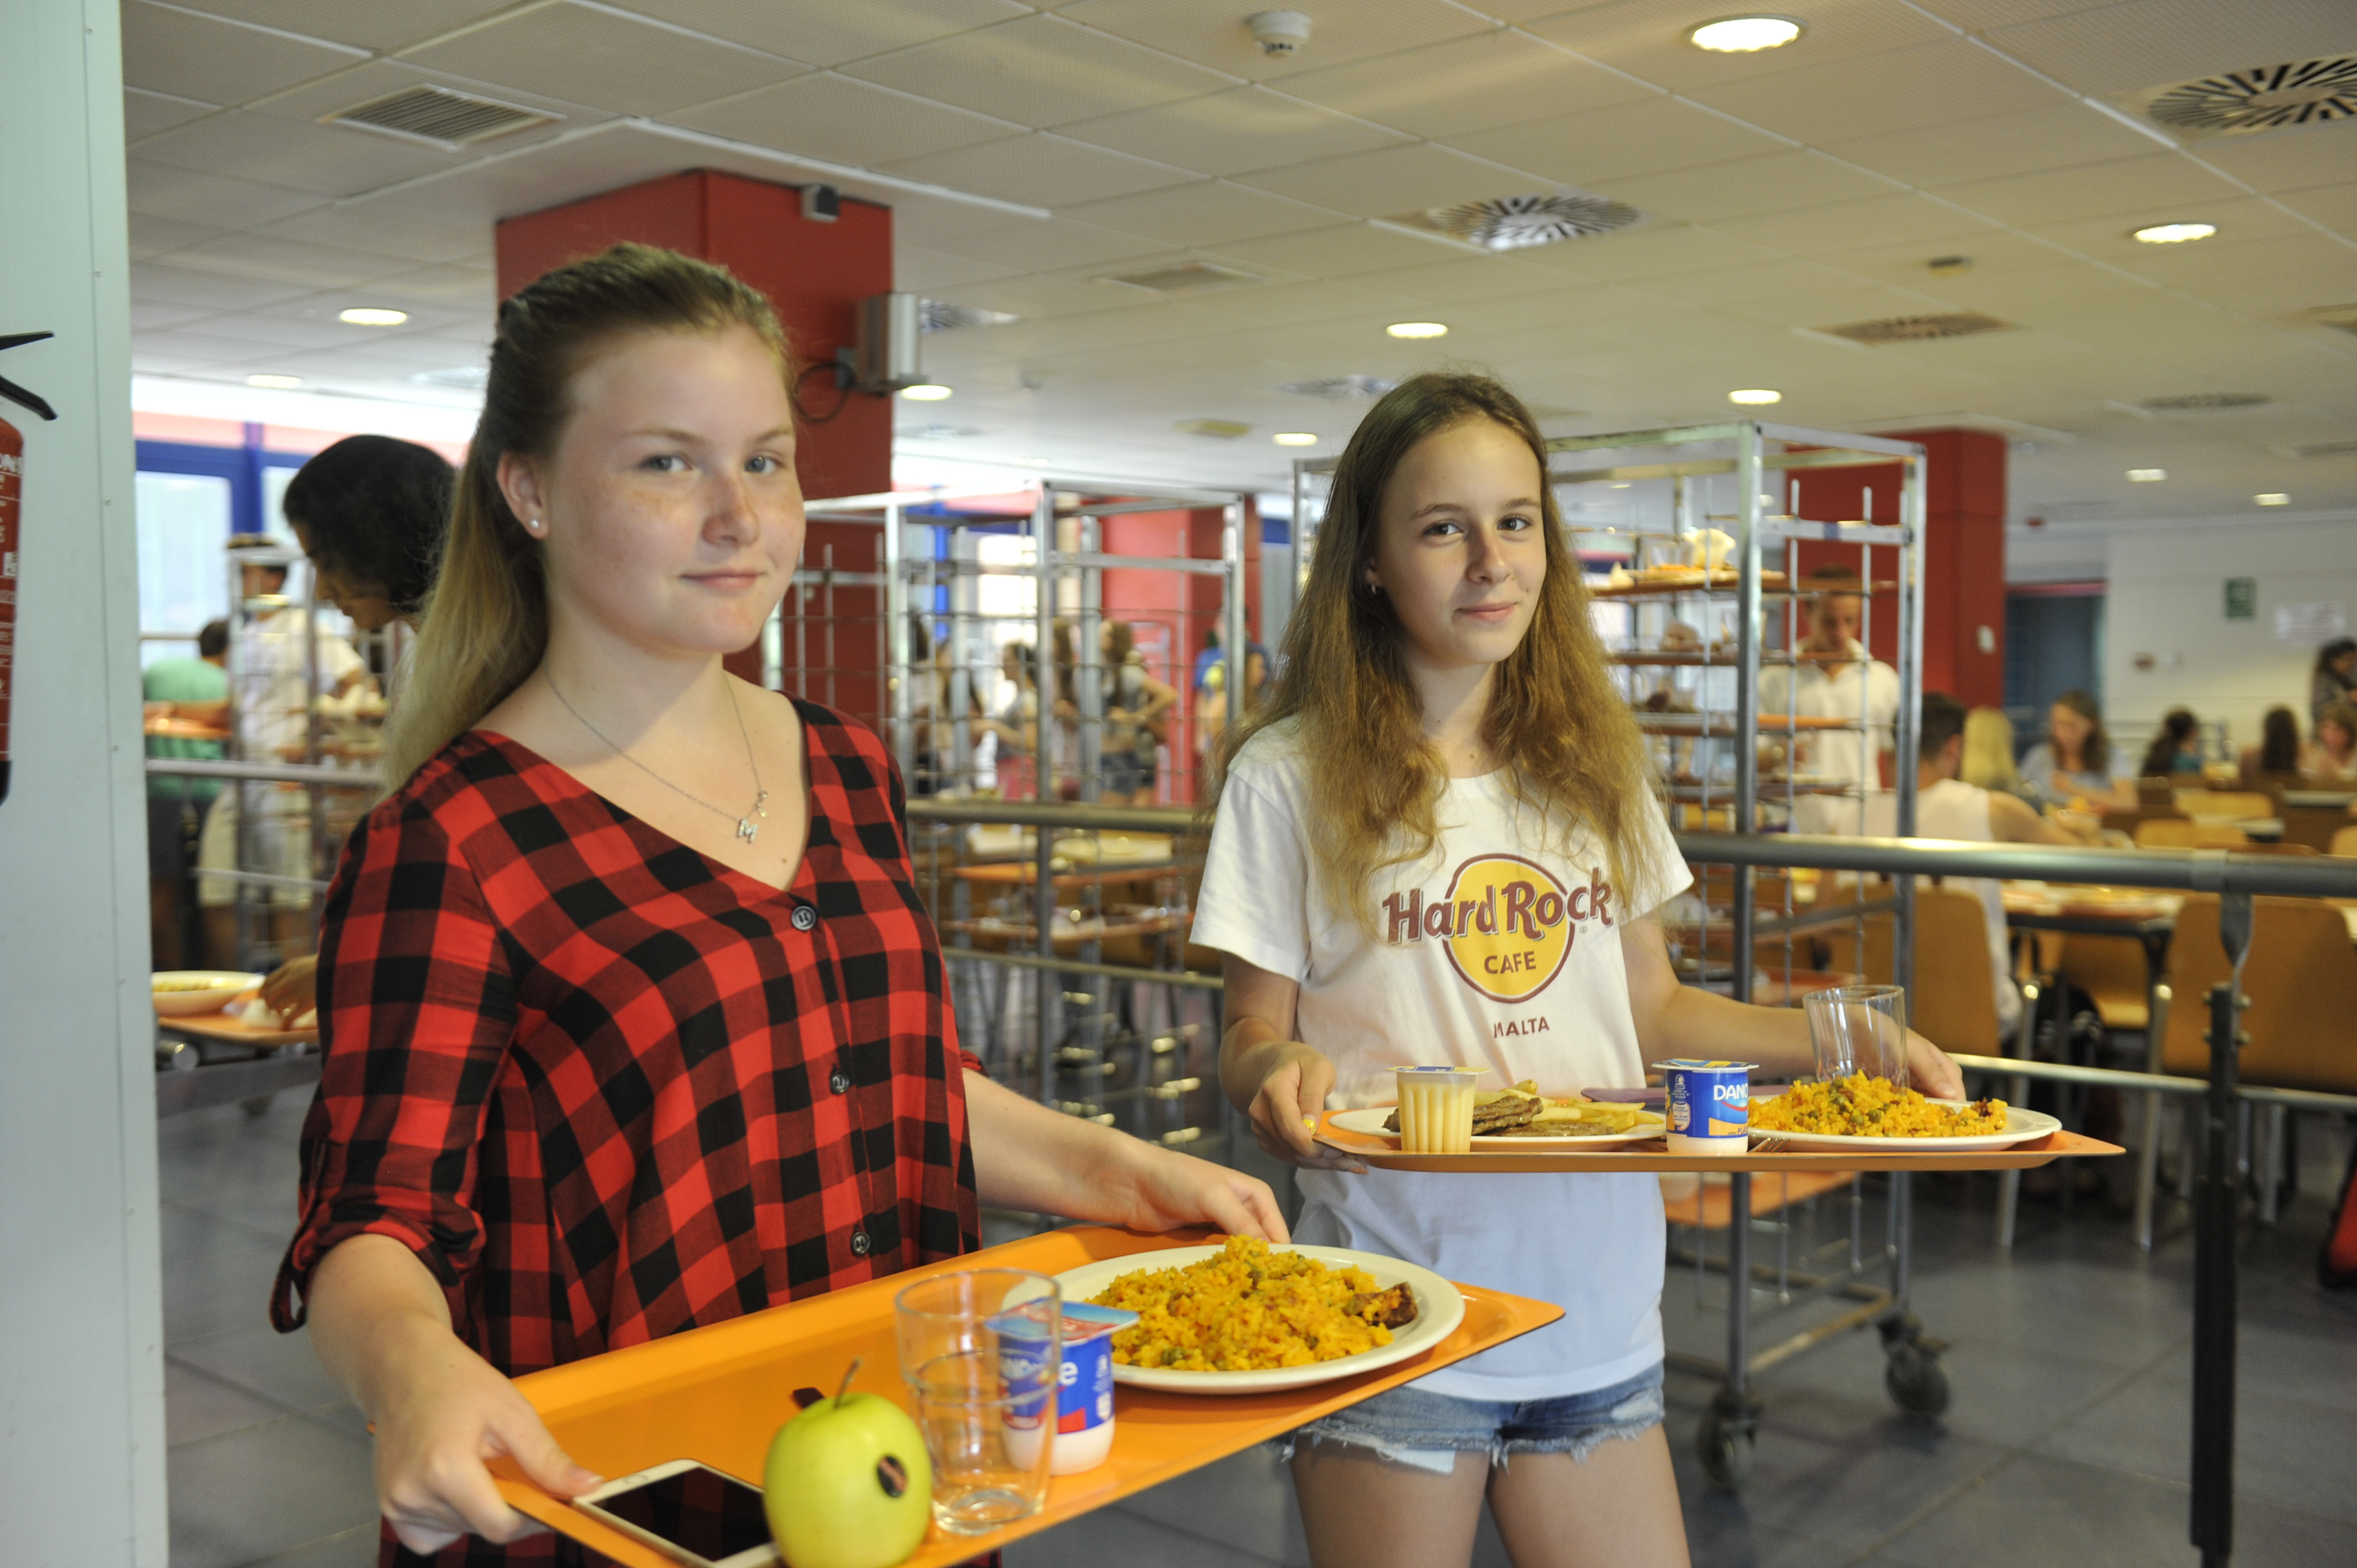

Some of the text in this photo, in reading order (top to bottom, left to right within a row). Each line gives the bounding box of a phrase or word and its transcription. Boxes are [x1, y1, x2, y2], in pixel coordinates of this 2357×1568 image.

[1382, 867, 1613, 946] Hard Rock
[1484, 950, 1537, 974] CAFE
[1494, 1016, 1550, 1039] MALTA
